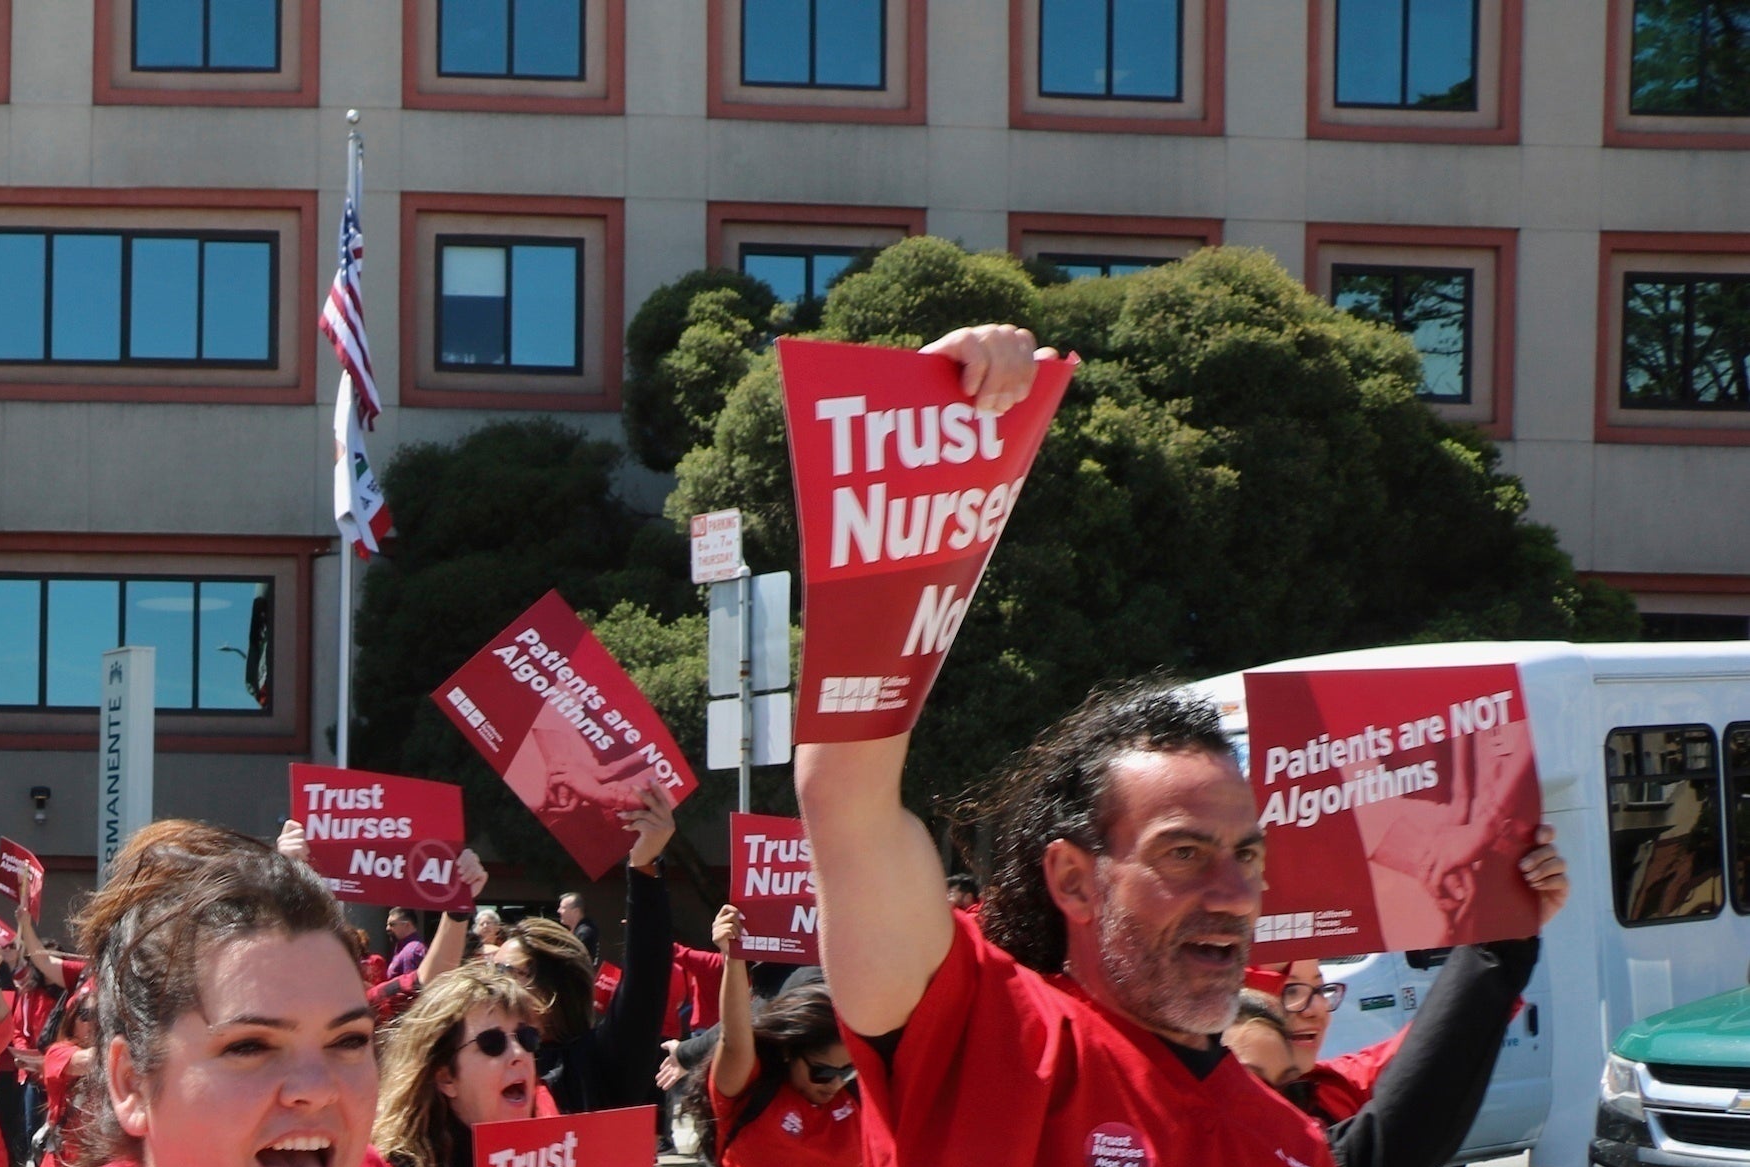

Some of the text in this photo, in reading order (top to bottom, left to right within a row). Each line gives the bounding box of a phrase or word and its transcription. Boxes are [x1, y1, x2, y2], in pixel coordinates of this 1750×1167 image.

[815, 395, 1005, 477] Trust
[492, 644, 615, 752] Algorithms
[515, 627, 684, 789] Patients are NOT
[1264, 690, 1513, 785] Patients are NOT
[303, 783, 384, 811] Trust
[1257, 760, 1439, 829] Algorithms
[305, 813, 412, 841] Nurses
[744, 834, 814, 864] Trus
[349, 849, 453, 885] Not AI
[745, 866, 817, 897] Nurs
[1092, 1144, 1144, 1158] Nurses
[1093, 1133, 1132, 1147] Trust
